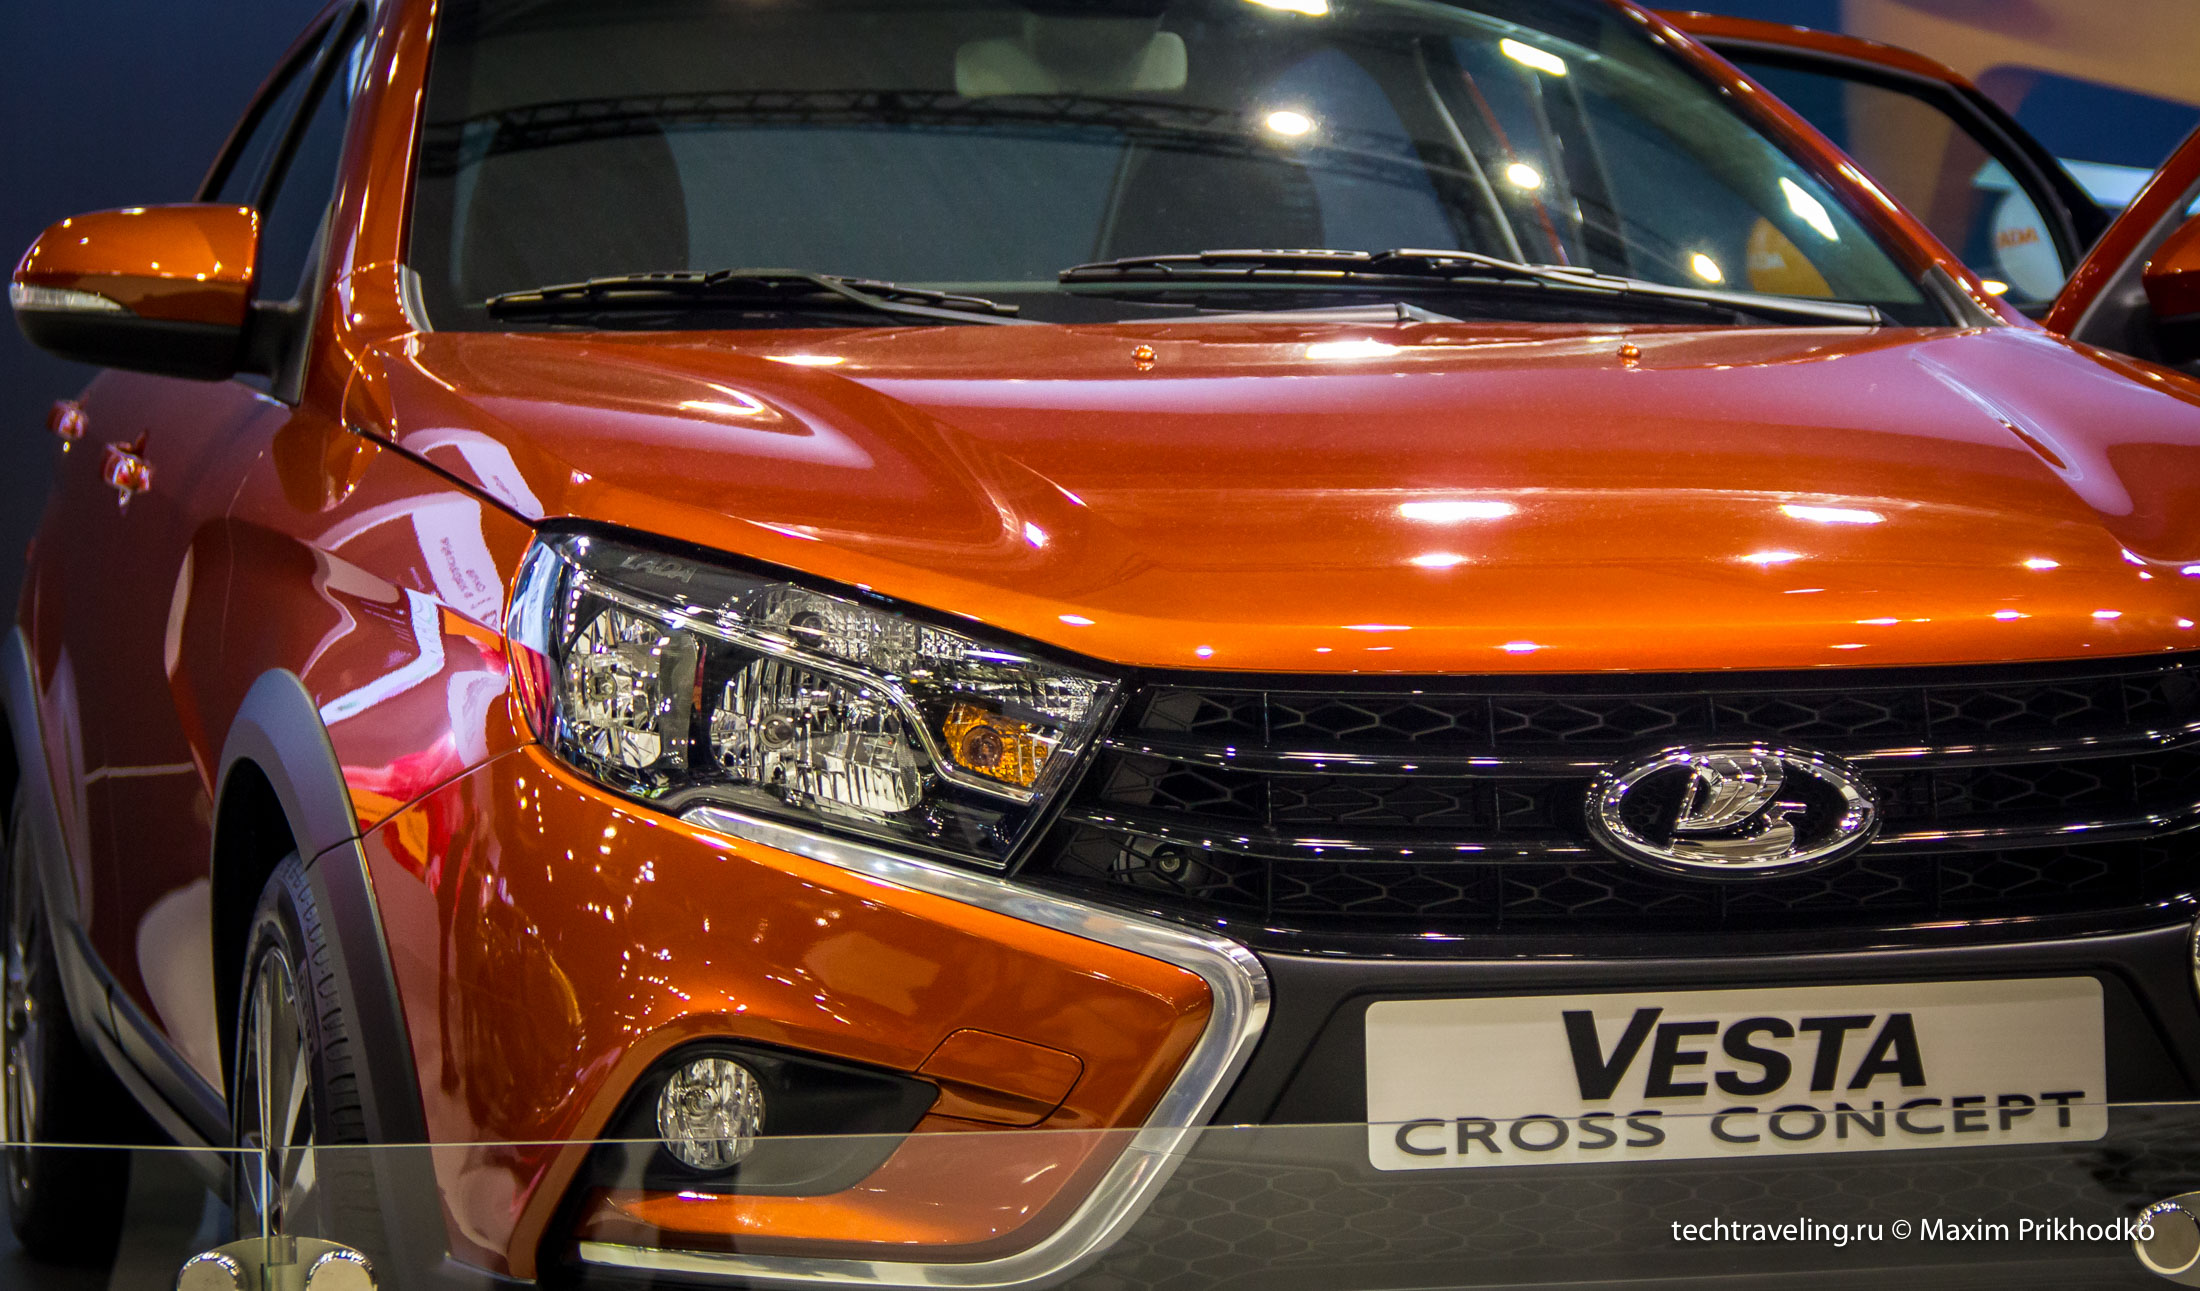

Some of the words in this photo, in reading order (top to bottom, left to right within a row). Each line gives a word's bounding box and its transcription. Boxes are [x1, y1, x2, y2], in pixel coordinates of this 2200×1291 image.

[1562, 1006, 1927, 1100] VESTA
[1395, 1110, 1666, 1157] CROSS
[1710, 1091, 2086, 1143] CONCEPT
